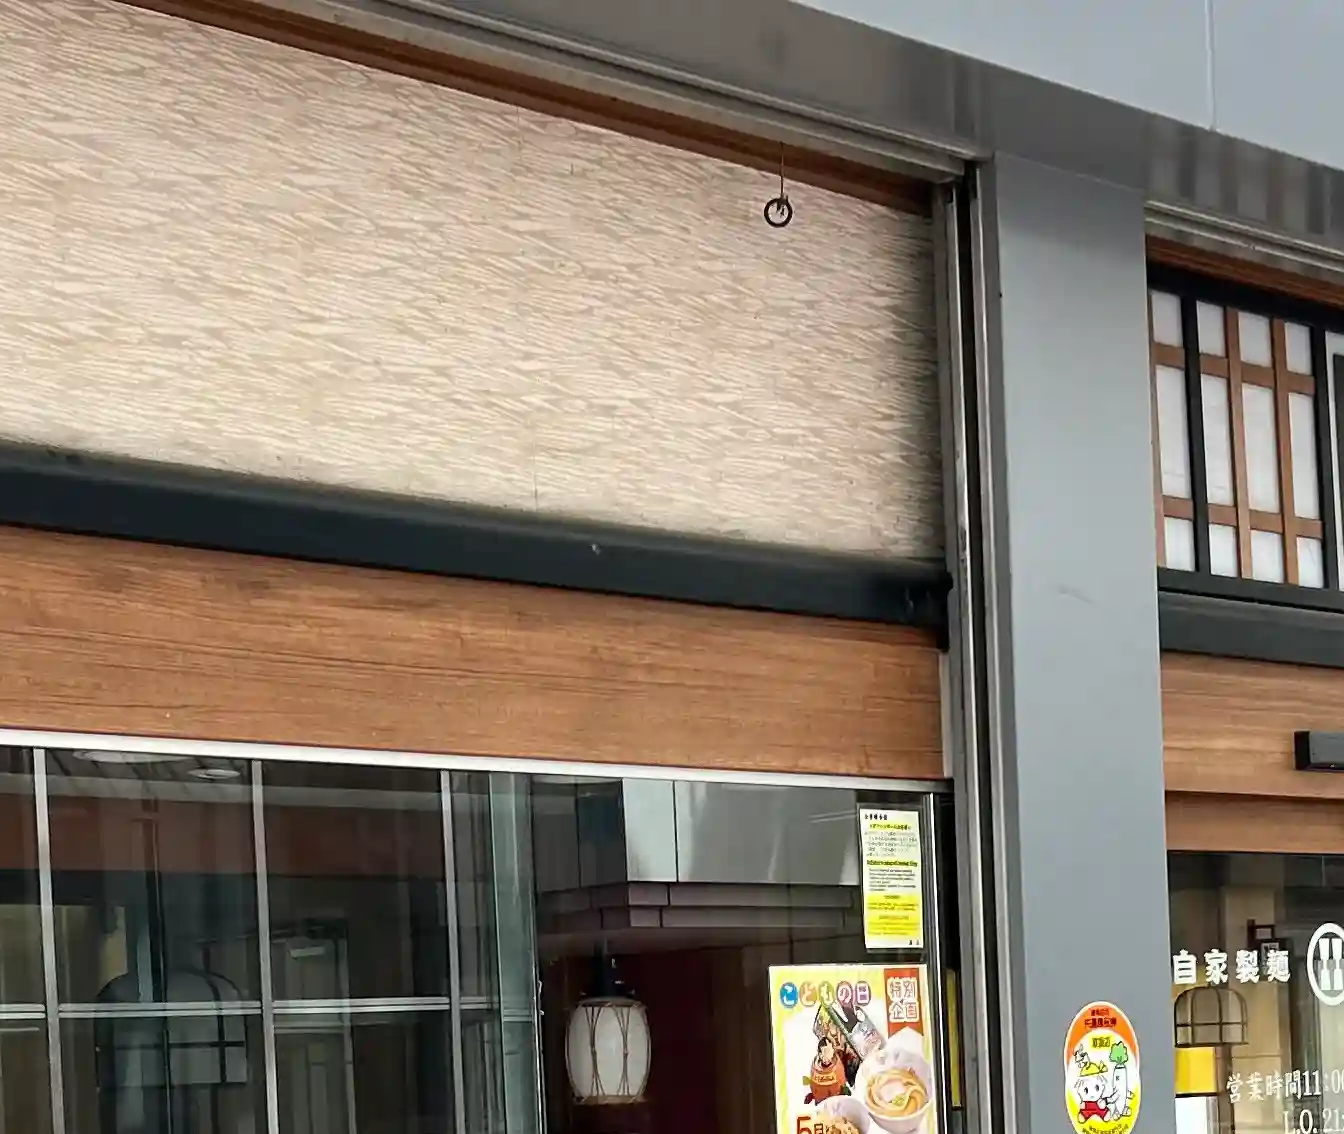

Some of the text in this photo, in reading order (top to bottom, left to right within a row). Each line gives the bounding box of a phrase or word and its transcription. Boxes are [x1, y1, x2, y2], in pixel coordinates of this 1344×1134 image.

[1172, 948, 1291, 985] 自家製麺
[779, 980, 872, 1009] こどもの日
[886, 977, 918, 999] 特別
[890, 1001, 920, 1022] 企画
